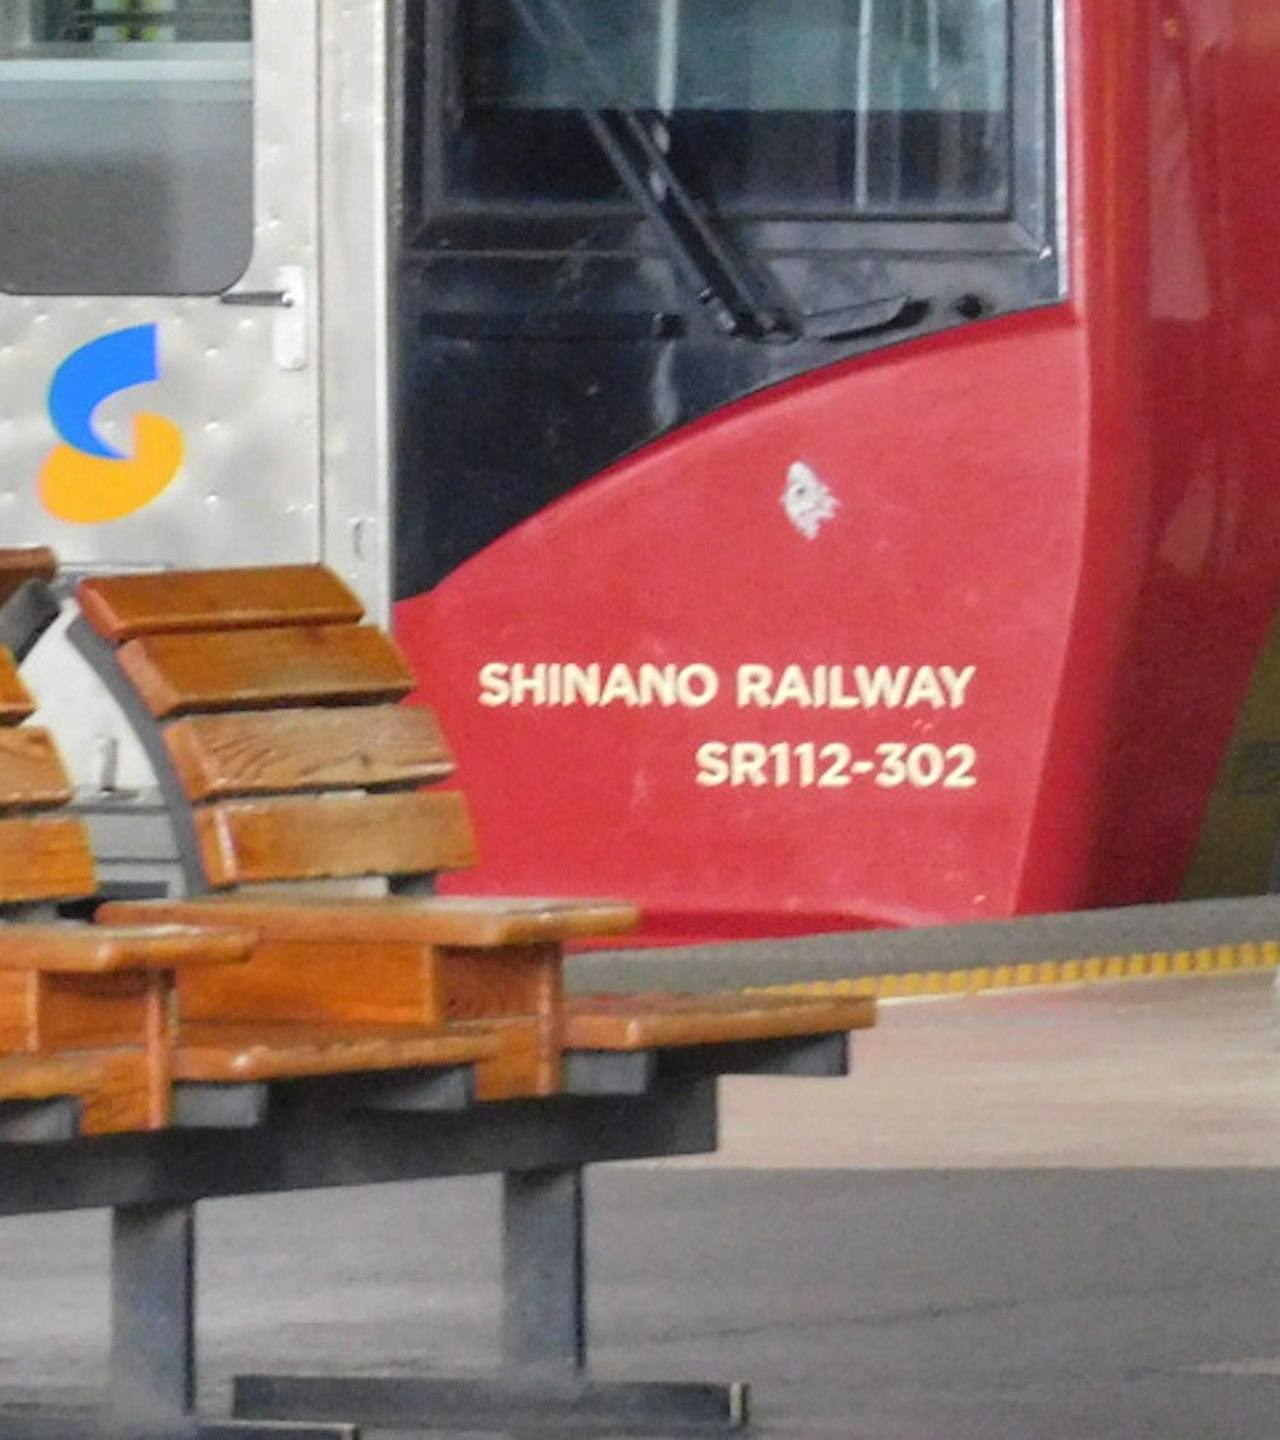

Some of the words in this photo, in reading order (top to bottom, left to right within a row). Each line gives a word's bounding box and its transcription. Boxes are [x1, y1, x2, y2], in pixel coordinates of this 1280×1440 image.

[477, 661, 720, 709] SHINANO
[736, 663, 977, 710] RAILWAY
[694, 741, 978, 789] SR112-302
